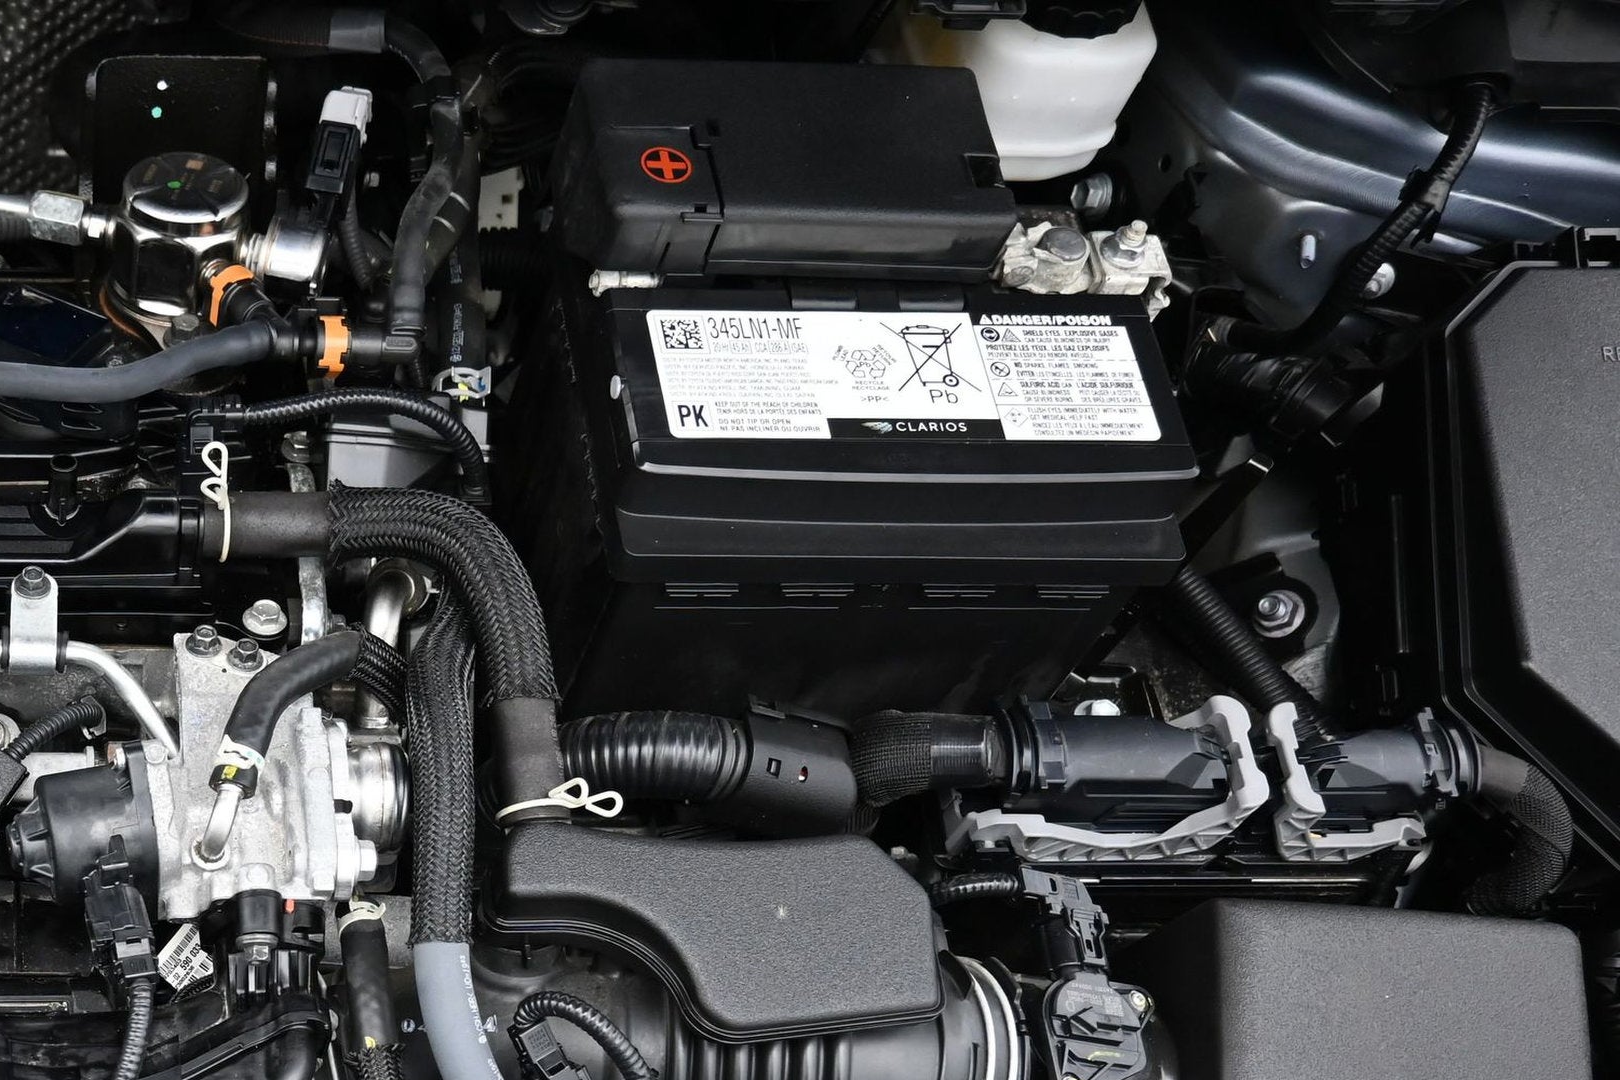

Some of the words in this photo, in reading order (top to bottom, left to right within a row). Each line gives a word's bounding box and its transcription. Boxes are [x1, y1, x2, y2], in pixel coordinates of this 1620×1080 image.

[707, 317, 802, 339] 345LN1-MF
[991, 314, 1112, 326] DANGER/POISON
[929, 389, 959, 404] Pb
[677, 404, 709, 427] PK
[895, 421, 968, 432] CLARIOS
[179, 955, 193, 971] 590
[189, 942, 201, 958] 033
